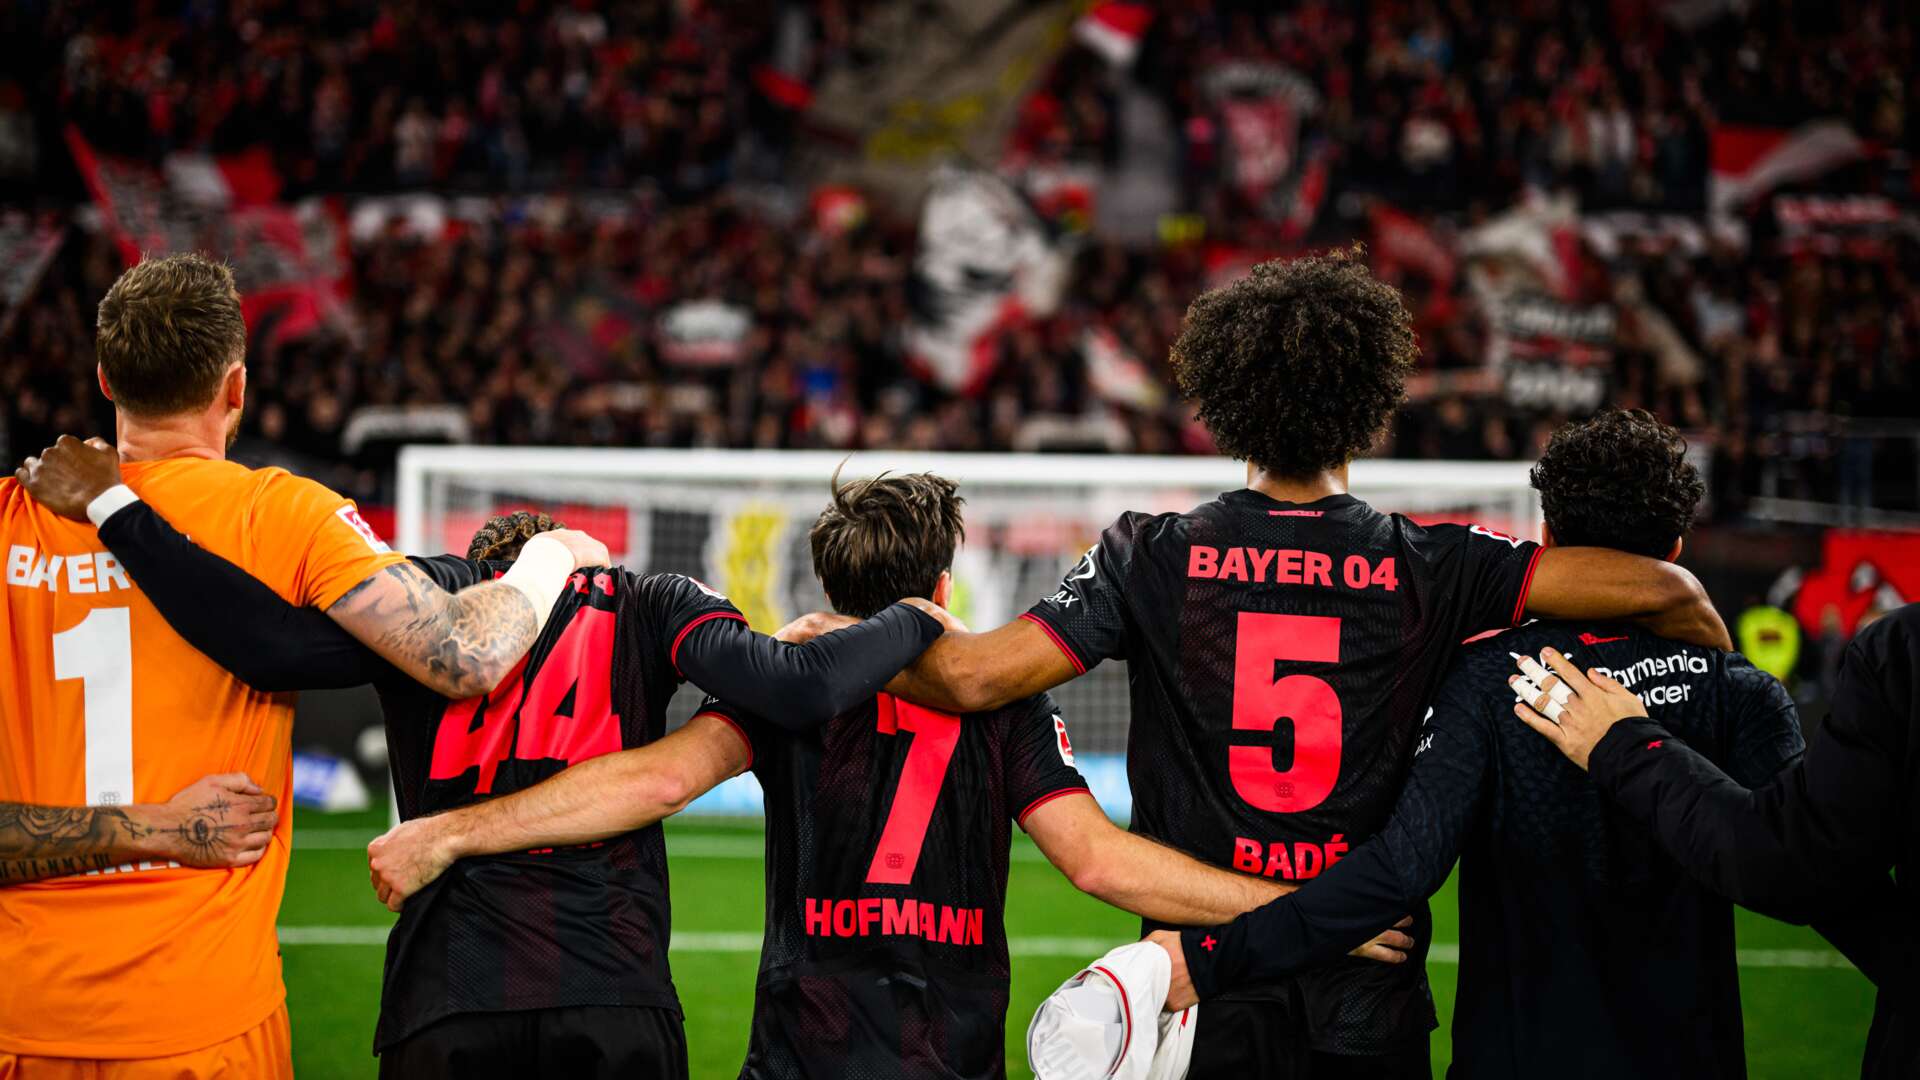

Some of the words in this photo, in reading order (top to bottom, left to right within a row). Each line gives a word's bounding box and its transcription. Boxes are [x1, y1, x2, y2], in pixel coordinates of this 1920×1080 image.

[7, 544, 131, 594] BAYER
[1187, 545, 1334, 586] BAYER
[1343, 554, 1399, 591] 04
[52, 606, 134, 807] 1
[429, 605, 623, 794] 44
[1228, 611, 1343, 814] 5
[865, 691, 961, 885] 7
[1232, 834, 1350, 881] BADÉ
[805, 897, 984, 946] HOFMANN
